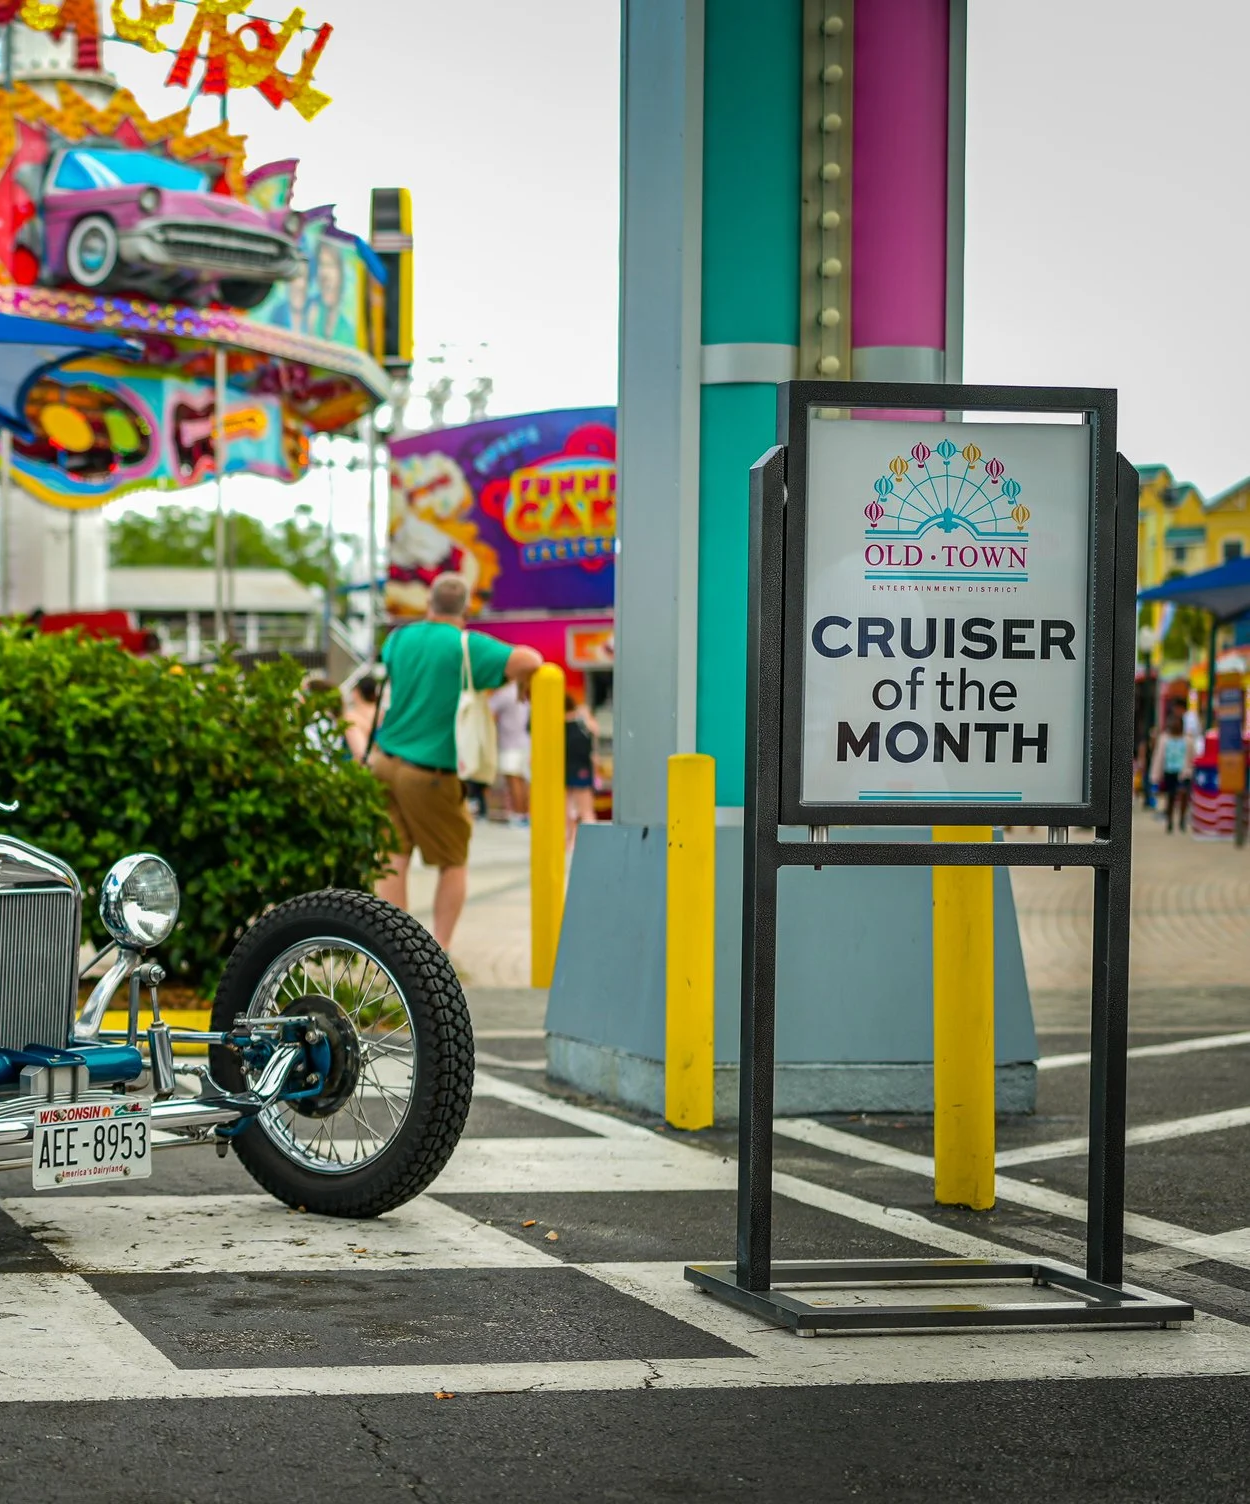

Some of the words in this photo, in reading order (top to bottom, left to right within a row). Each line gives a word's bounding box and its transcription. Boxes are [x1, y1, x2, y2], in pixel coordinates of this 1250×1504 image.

[516, 499, 616, 531] CAK
[864, 544, 923, 567] OLD
[941, 546, 1028, 569] TOWN
[811, 615, 1077, 660] CRUISER
[872, 666, 925, 711] of
[935, 667, 1017, 712] the
[836, 720, 1049, 763] MONTH
[38, 1121, 146, 1169] AEE-8953
[61, 1168, 92, 1178] America's
[93, 1164, 124, 1175] Dairyland
